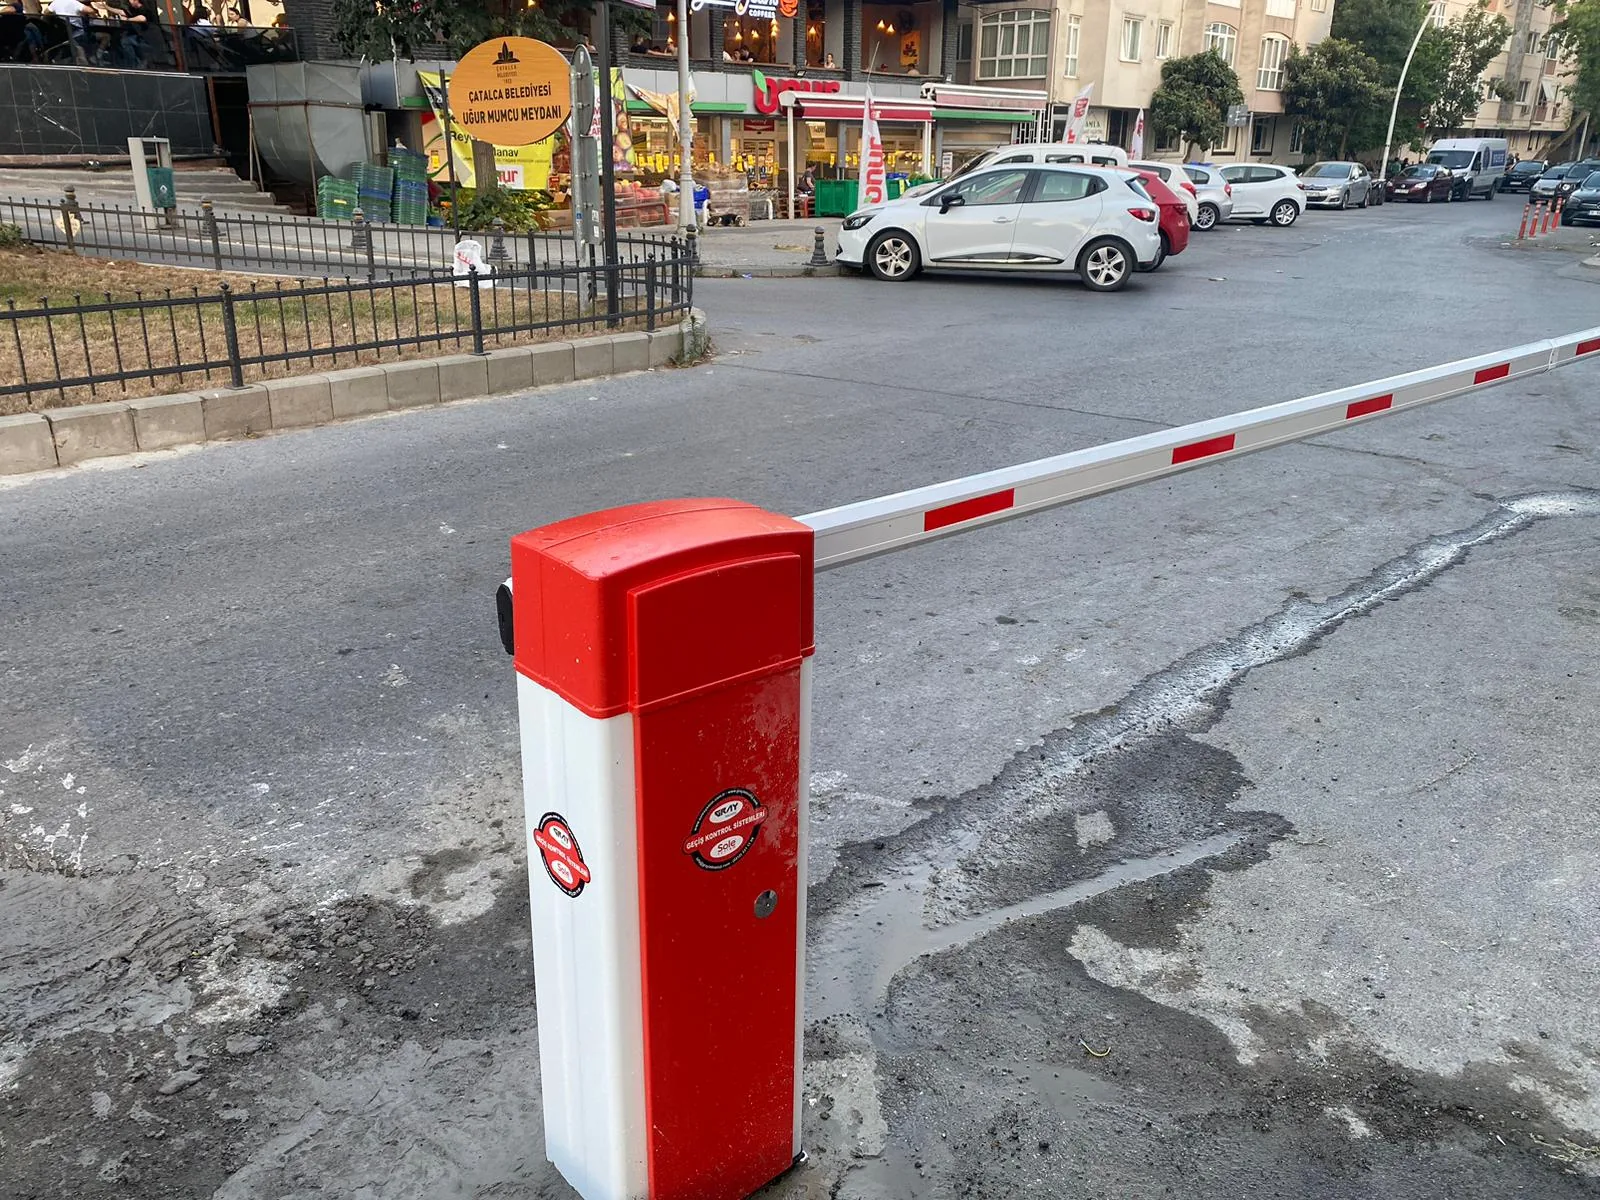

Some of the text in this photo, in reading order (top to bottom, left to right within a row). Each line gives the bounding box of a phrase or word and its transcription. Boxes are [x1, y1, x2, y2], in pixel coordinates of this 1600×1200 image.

[468, 88, 503, 103] ÇATALCA
[505, 81, 552, 99] BELEDİYESİ
[462, 105, 562, 125] UĞUR MUMCU MEYDANI
[493, 147, 519, 157] anav
[714, 802, 739, 818] GRAY
[686, 836, 705, 850] GEÇİŞ
[704, 825, 733, 842] KONTROL
[732, 809, 765, 830] SİSTEMLERİ
[716, 838, 737, 853] Sole
